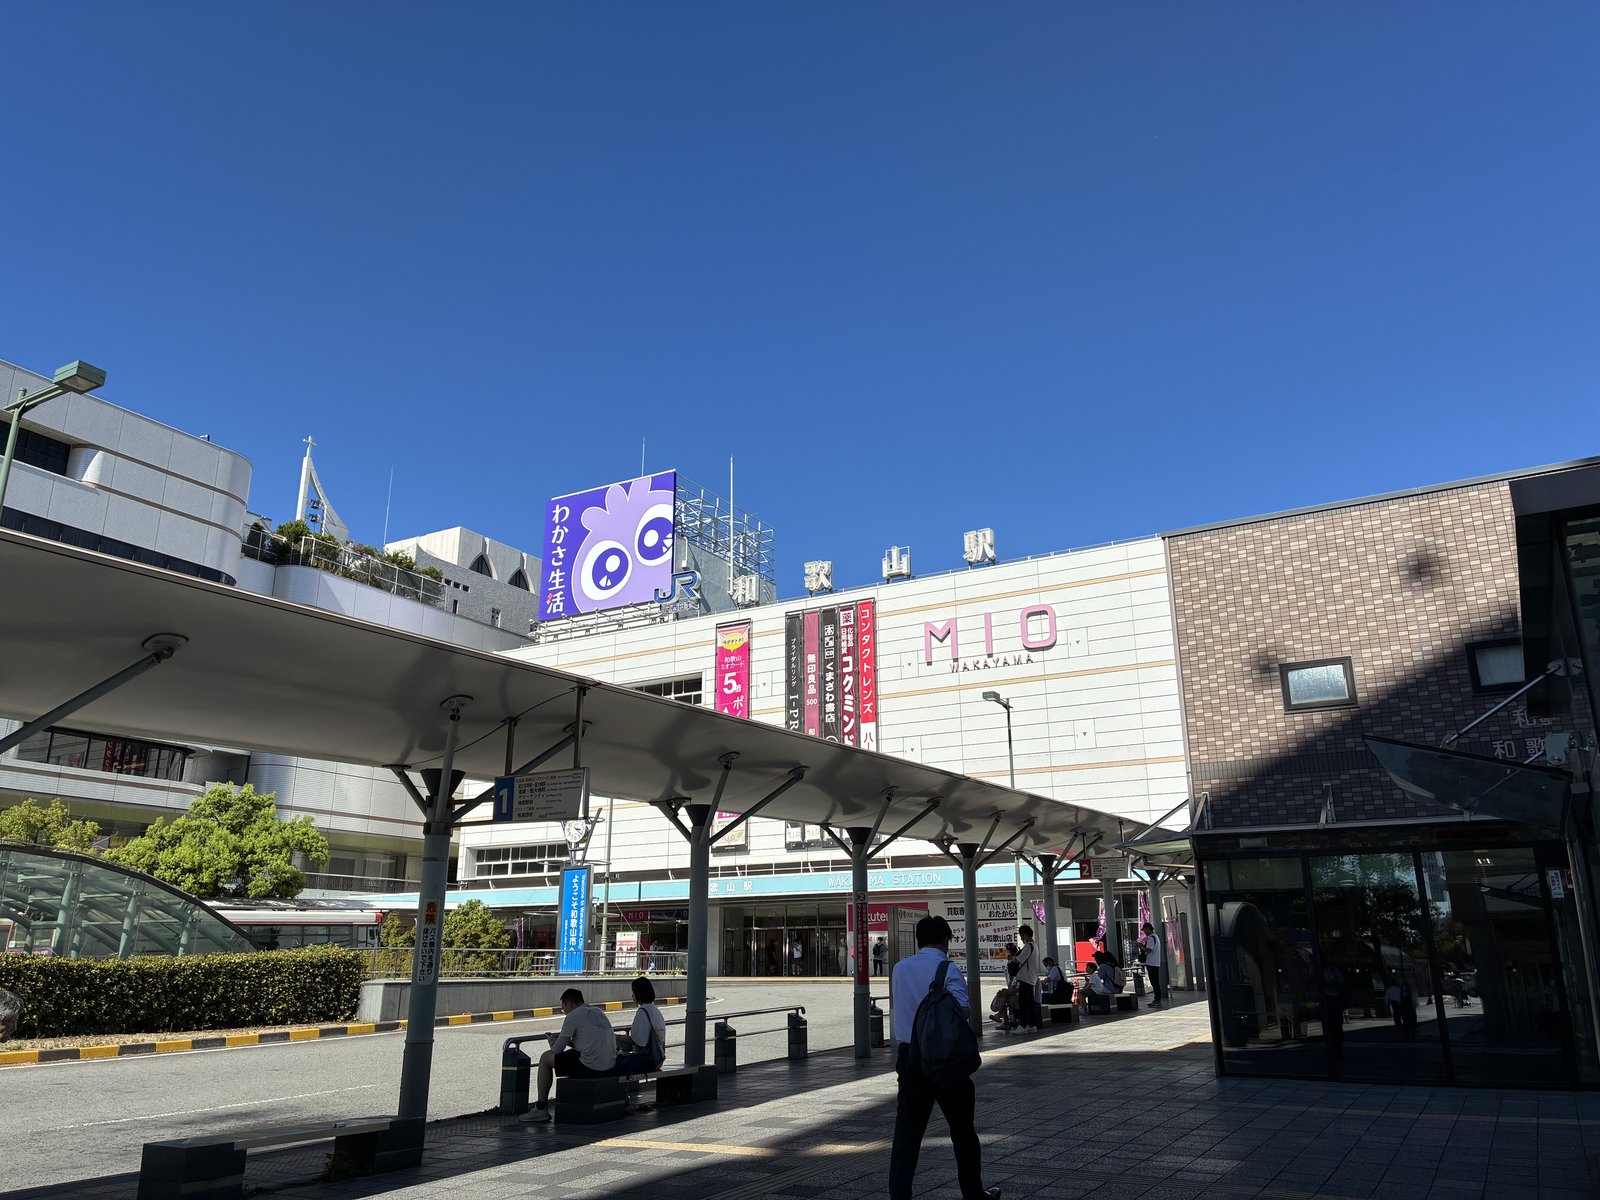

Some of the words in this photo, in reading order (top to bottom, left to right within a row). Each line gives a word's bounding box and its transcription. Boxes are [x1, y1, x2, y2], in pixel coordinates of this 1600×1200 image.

[547, 504, 570, 614] わかさ生活
[654, 570, 701, 604] JR
[842, 612, 852, 624] 薬
[924, 603, 1057, 666] MIO
[721, 660, 744, 670] ミオカード
[724, 655, 741, 663] 和歌山
[861, 609, 873, 714] コンタクトレンズ
[950, 653, 1034, 673] WAKAYAMA
[807, 654, 817, 694] 無印良品
[825, 662, 835, 723] くまざわ書店
[499, 788, 508, 814] 1
[828, 875, 885, 888] WAKMA
[892, 873, 942, 886] STATION
[1082, 864, 1090, 876] 2
[424, 901, 436, 925] 危険
